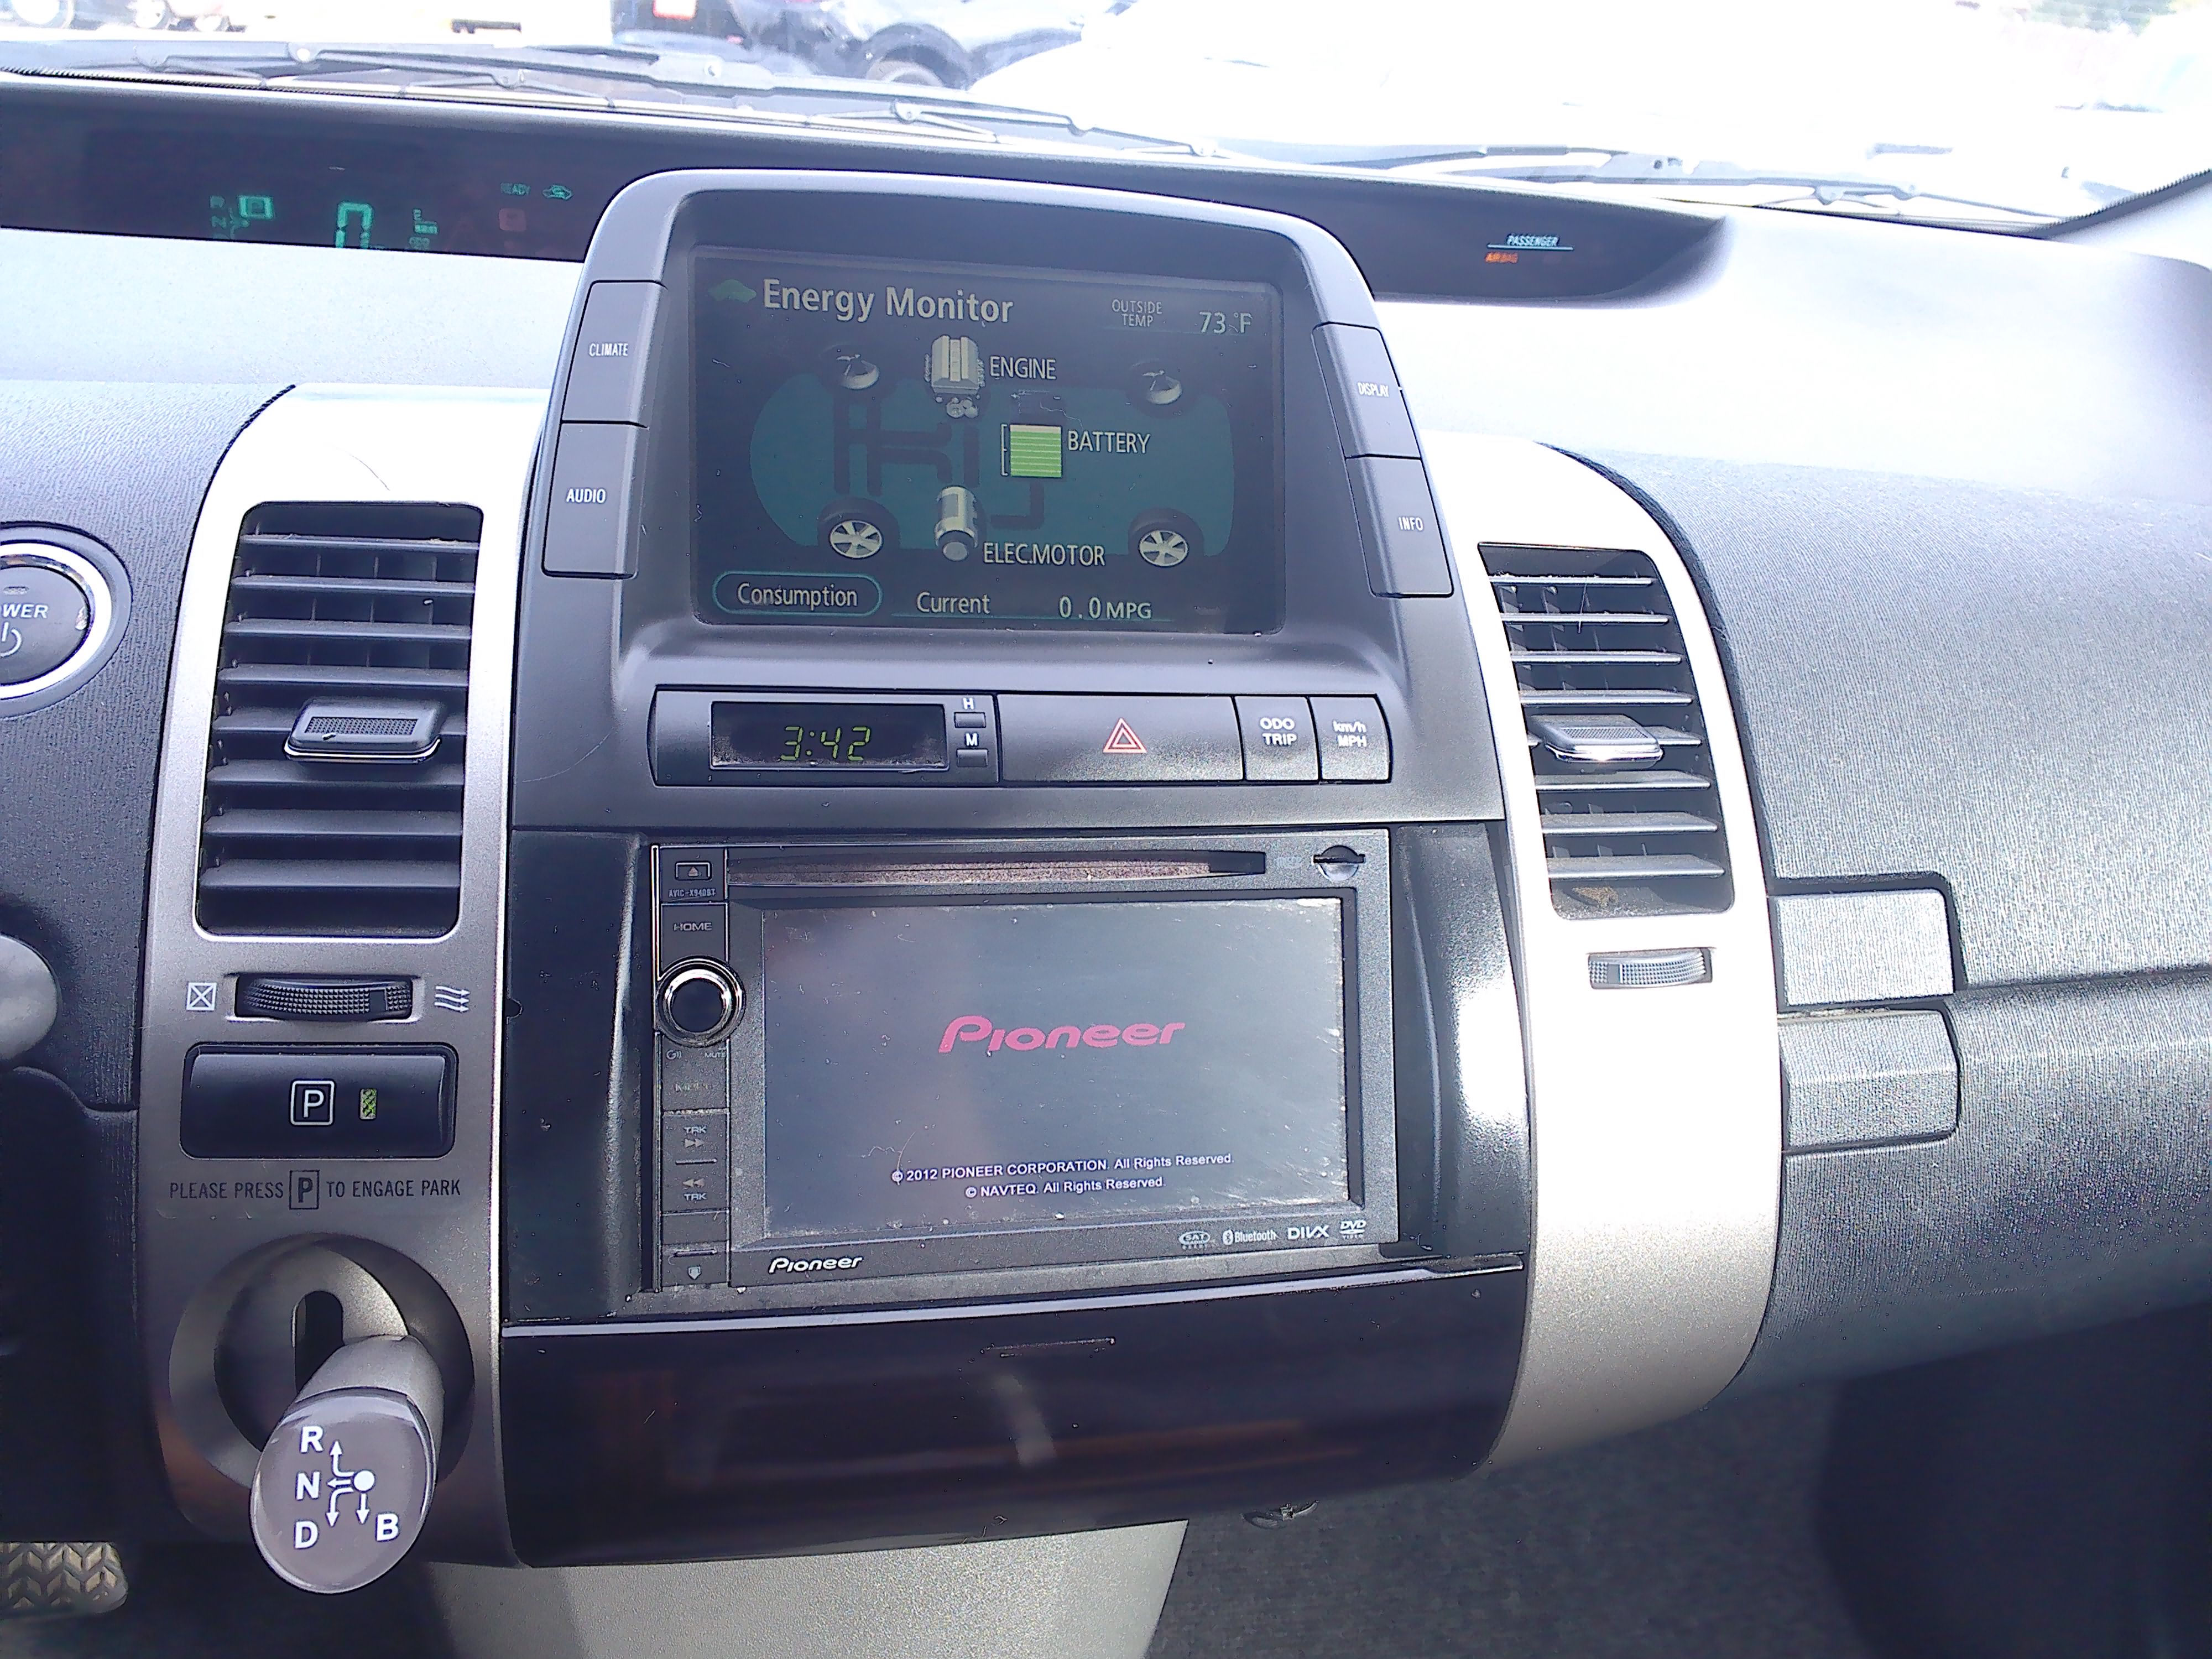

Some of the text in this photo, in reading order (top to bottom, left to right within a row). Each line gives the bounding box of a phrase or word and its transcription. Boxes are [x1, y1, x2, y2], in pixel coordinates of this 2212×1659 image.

[1506, 234, 1559, 247] PASSENGER
[763, 278, 1014, 322] Energy Monitor
[1112, 299, 1162, 315] OUTSIDE
[1121, 313, 1154, 327] TEMP
[1199, 311, 1226, 334] 73
[589, 343, 629, 357] CLIMATE
[989, 356, 1056, 379] ENGINE
[1358, 382, 1390, 398] DISPLAY
[1068, 430, 1151, 454] BATTERY
[566, 488, 606, 504] AUDIO
[1399, 517, 1424, 531] INFO
[983, 542, 1105, 567] ELEC.MOTOR
[737, 582, 858, 609] Consumption
[917, 592, 991, 615] Current
[1106, 601, 1152, 619] MPG
[963, 698, 974, 709] H
[1260, 717, 1295, 730] ODO
[1332, 720, 1366, 733] km/h
[780, 726, 871, 761] 3:42
[966, 733, 978, 747] M
[1262, 733, 1297, 746] TRIP
[1337, 734, 1368, 747] MPH
[669, 888, 716, 898] AVIC-X940BT
[673, 922, 712, 931] HOME
[938, 1015, 1186, 1052] Pioneer
[302, 1089, 324, 1118] P
[906, 1168, 938, 1182] 2012
[942, 1164, 1003, 1179] PIONEER
[1114, 1159, 1130, 1170] All
[1134, 1157, 1172, 1170] Rights
[169, 1177, 461, 1203] PLEASE PRESS P TO ENGAGE PARK
[1043, 1181, 1060, 1193] All
[1064, 1180, 1102, 1194] Rights
[1340, 1219, 1366, 1229] DVD
[1234, 1230, 1276, 1243] Bluetooth
[769, 1256, 863, 1274] Pioneer
[301, 1426, 324, 1453] R
[296, 1472, 321, 1500] N
[294, 1520, 319, 1549] D
[376, 1513, 399, 1541] B
